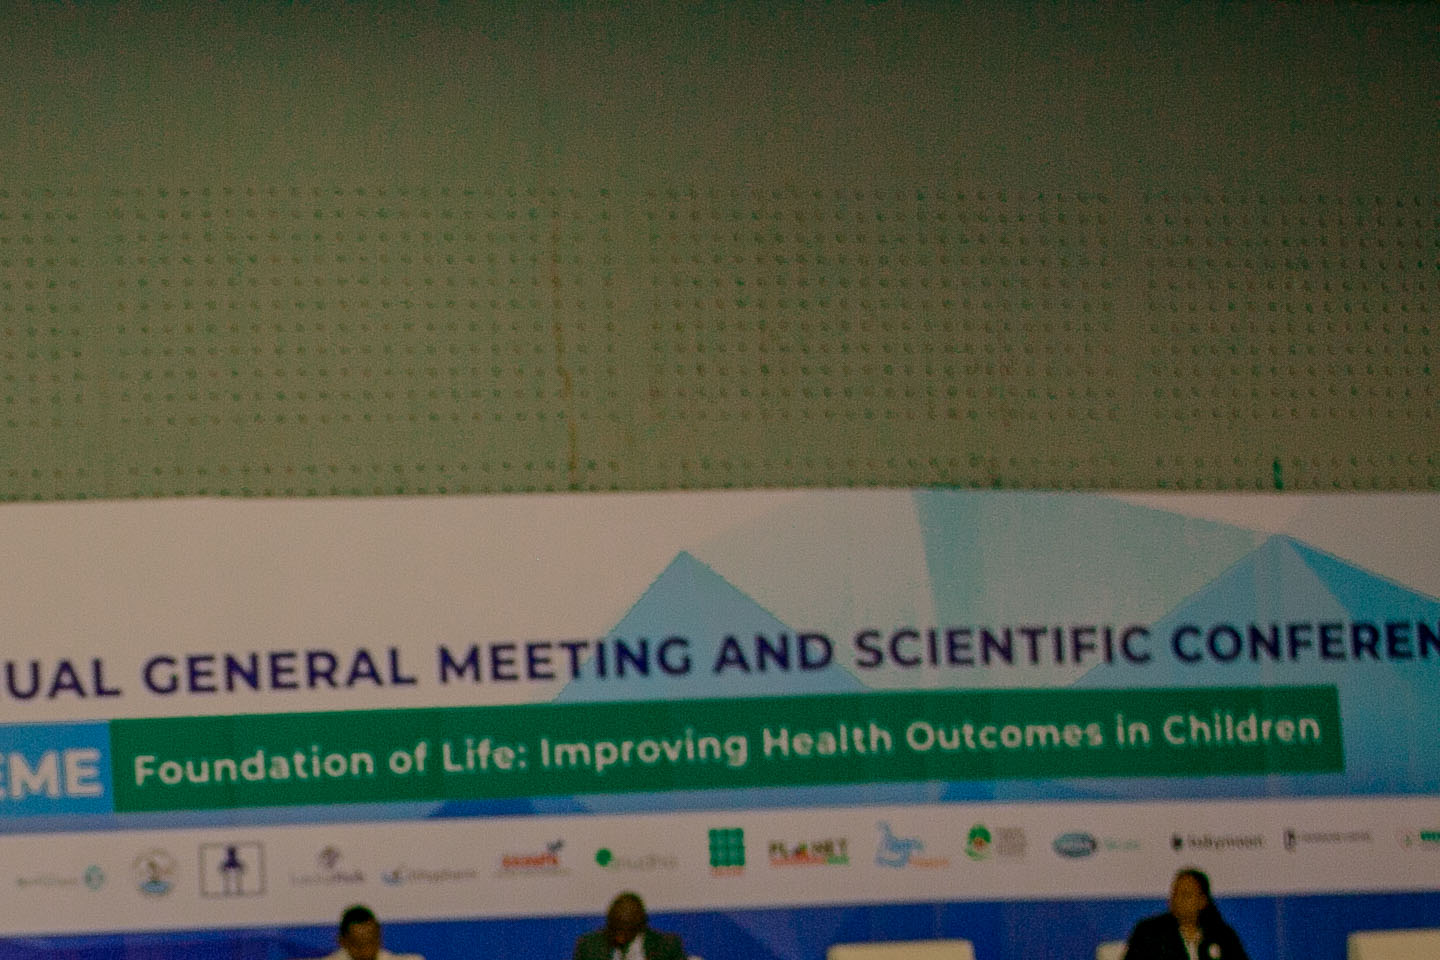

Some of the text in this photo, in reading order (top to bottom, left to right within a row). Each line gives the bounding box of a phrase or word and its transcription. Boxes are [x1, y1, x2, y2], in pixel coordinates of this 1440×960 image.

[141, 646, 418, 696] GENERAL
[437, 636, 693, 686] MEETING
[712, 629, 834, 675] AND
[854, 624, 1152, 670] SCIENTIFIC
[133, 710, 1322, 786] Foundation of Life: Improving Health Outcomes in Children
